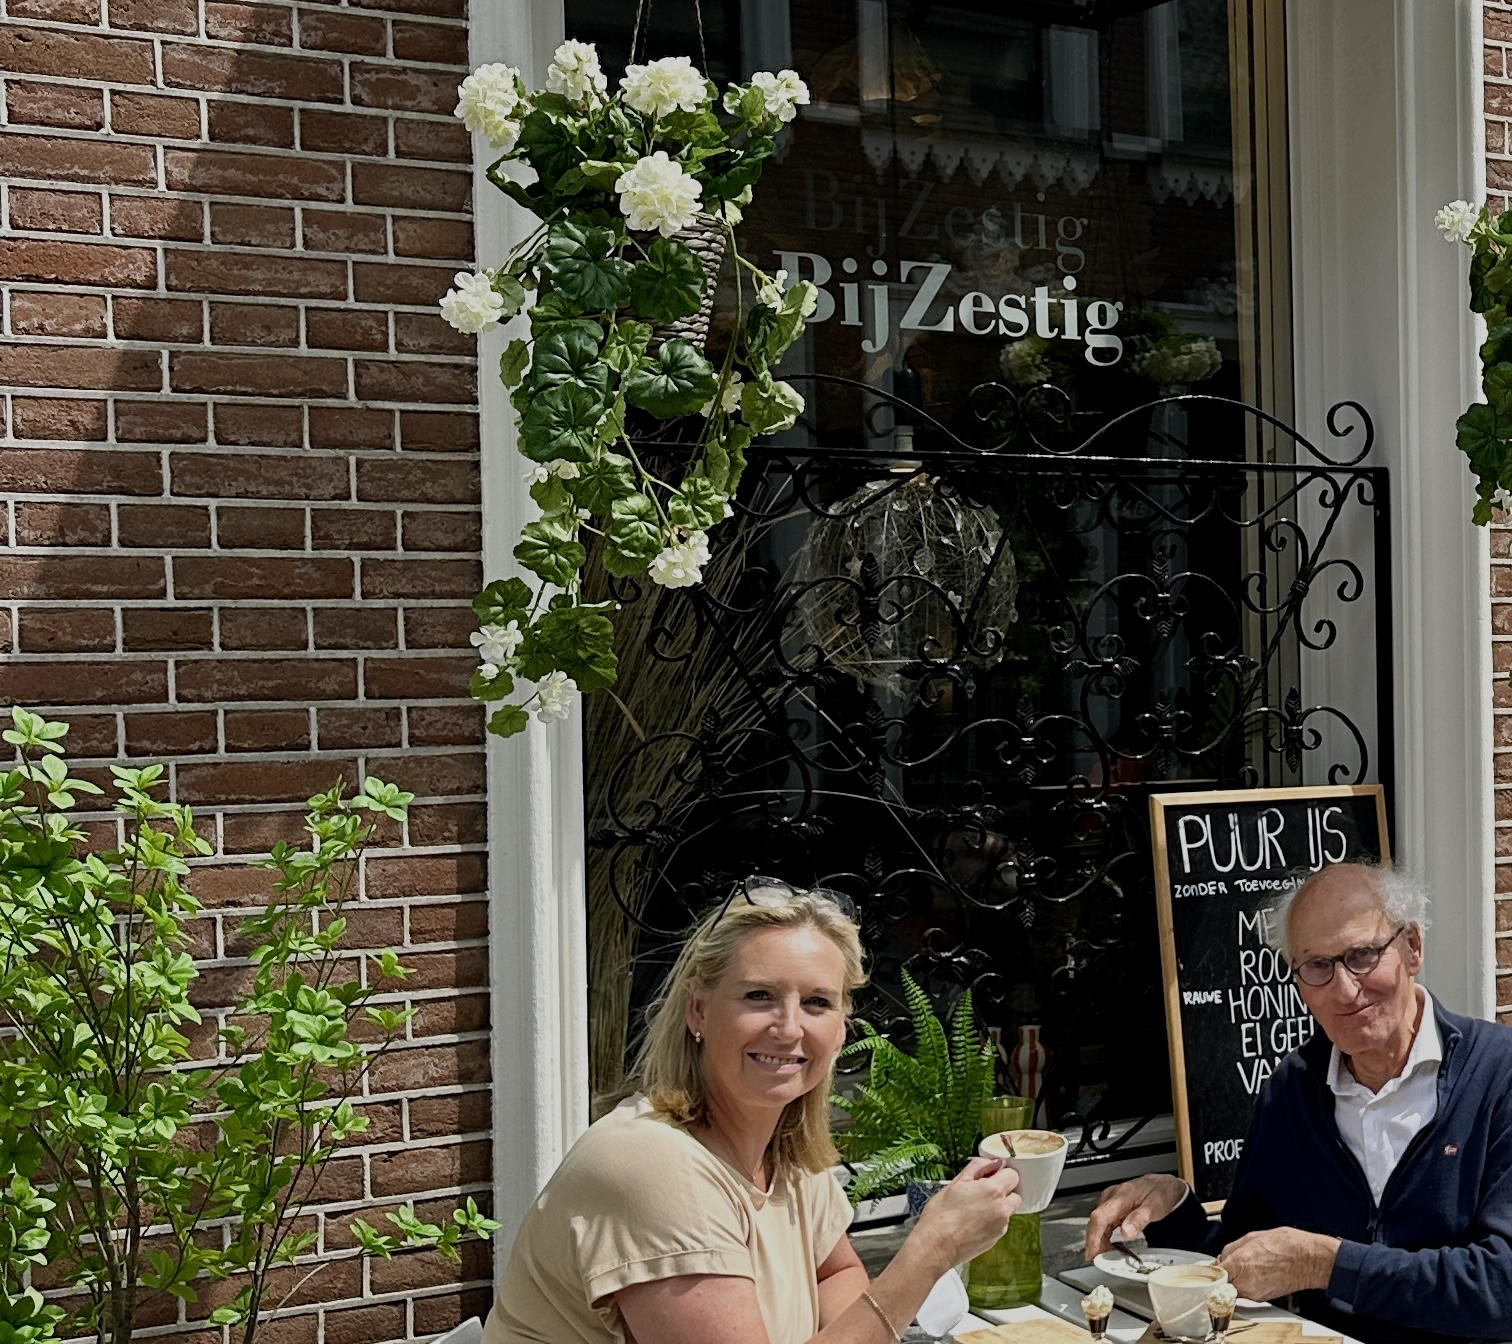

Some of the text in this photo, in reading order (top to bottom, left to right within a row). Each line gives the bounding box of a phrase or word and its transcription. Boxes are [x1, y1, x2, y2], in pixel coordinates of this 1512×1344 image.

[772, 249, 1124, 367] BijZestig
[1178, 806, 1347, 874] PUUR IJS
[1173, 876, 1306, 899] ZONDER TOEVOEGIN
[1238, 907, 1275, 946] ME
[1239, 947, 1297, 986] ROO
[1183, 982, 1308, 1024] RAUWE HONIN
[1240, 1021, 1263, 1058] EI
[1236, 1056, 1282, 1095] VA
